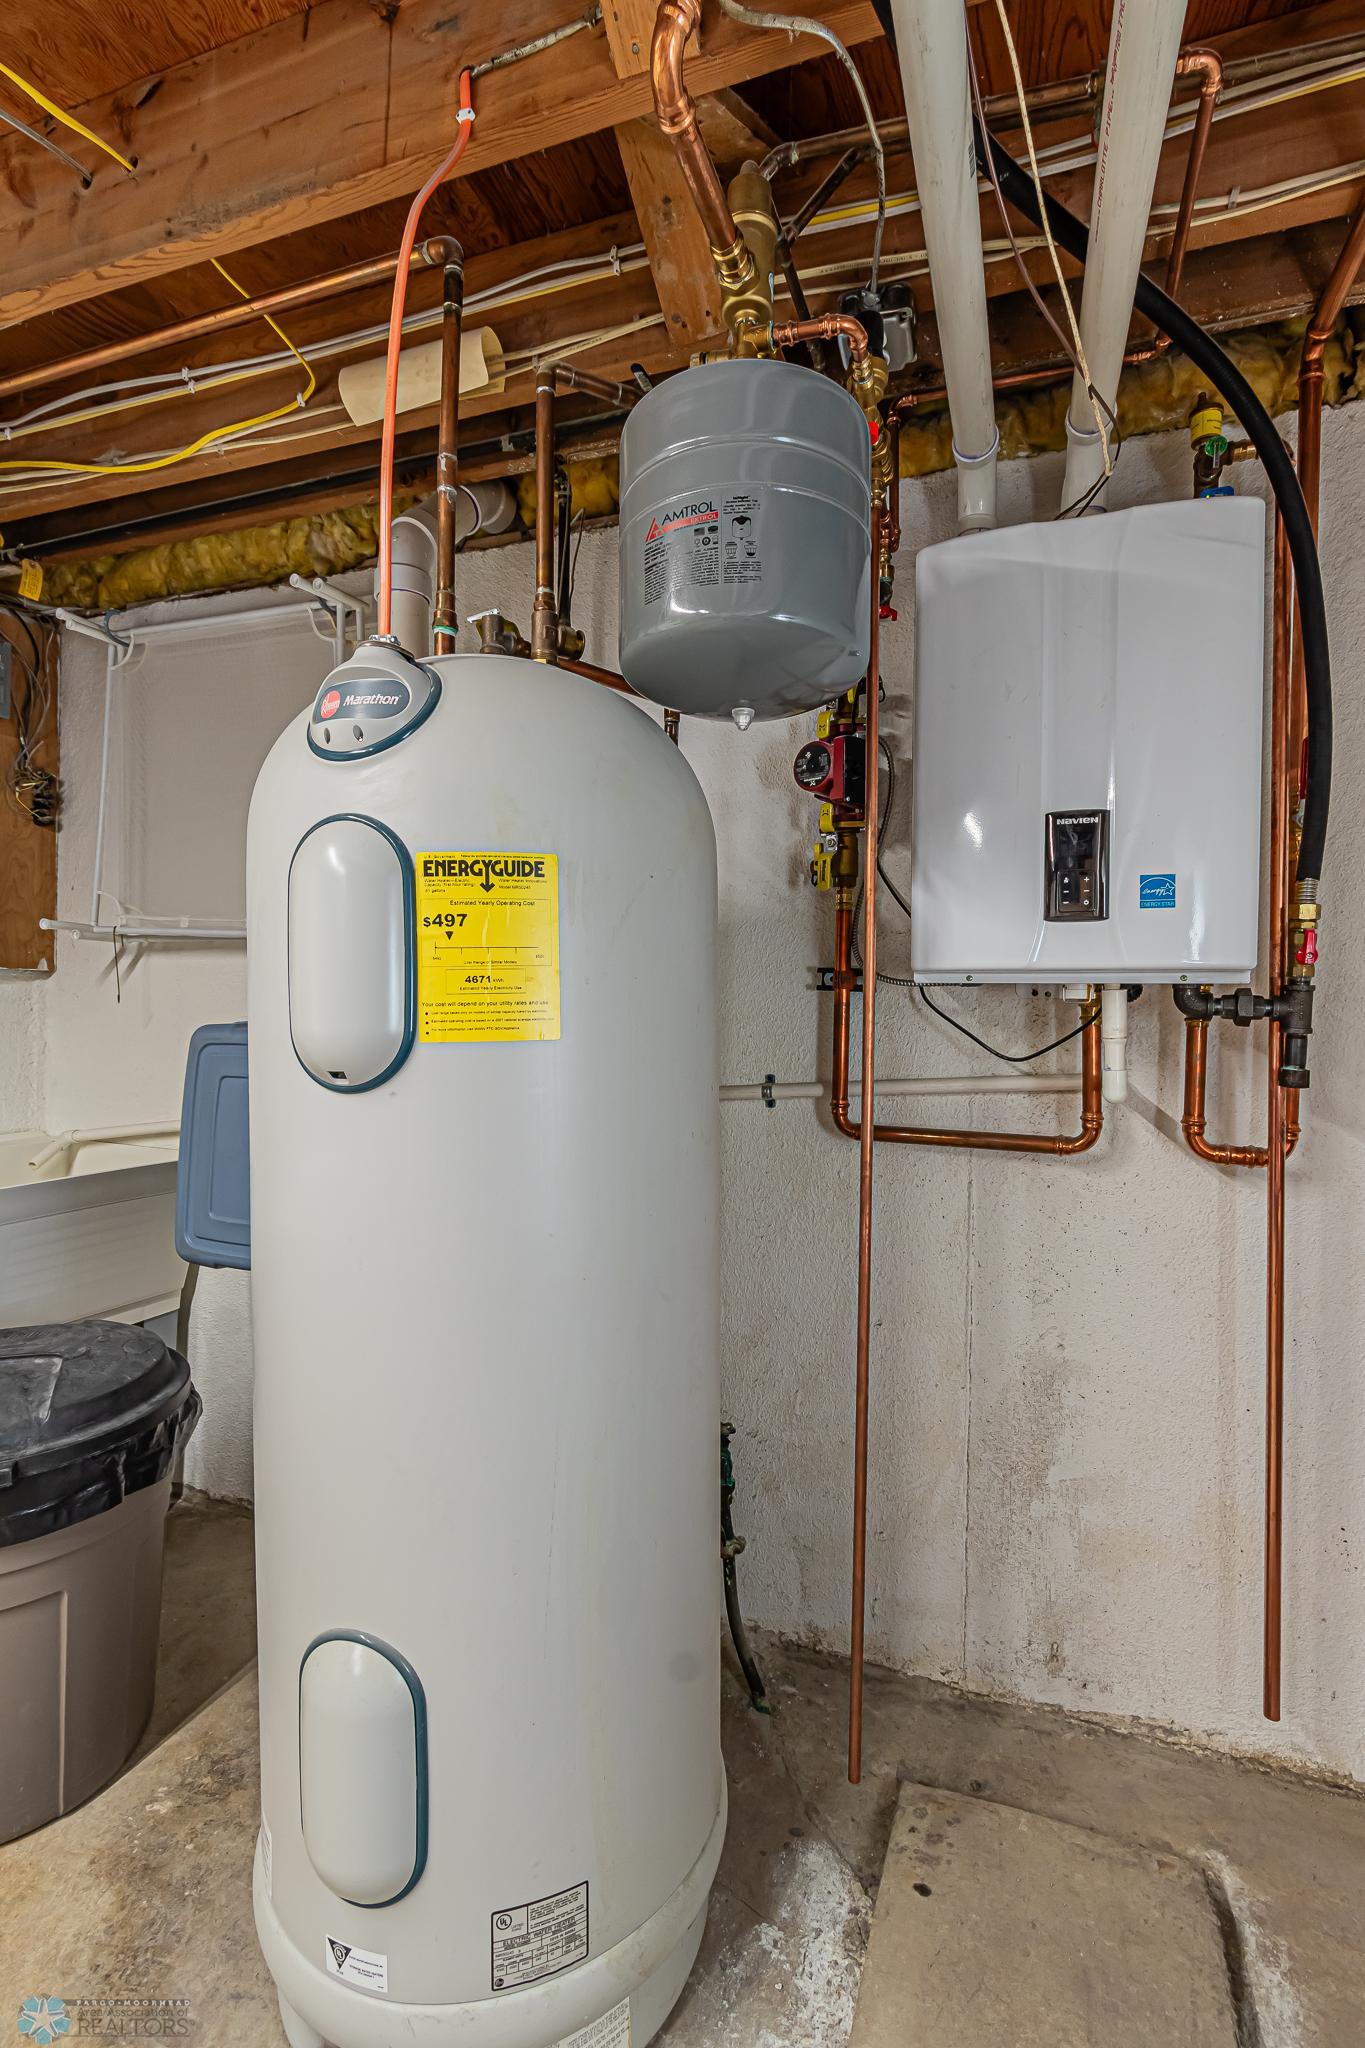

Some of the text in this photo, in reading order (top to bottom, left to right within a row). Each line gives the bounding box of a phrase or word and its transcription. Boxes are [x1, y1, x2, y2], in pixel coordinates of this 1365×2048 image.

[1097, 142, 1109, 208] CHARLOTTE
[661, 501, 718, 526] AMTROL
[343, 694, 399, 706] Marathon
[423, 859, 545, 878] ENERGYGUIDE
[423, 913, 468, 928] $497
[465, 975, 491, 984] 4671
[499, 1000, 513, 1008] utility
